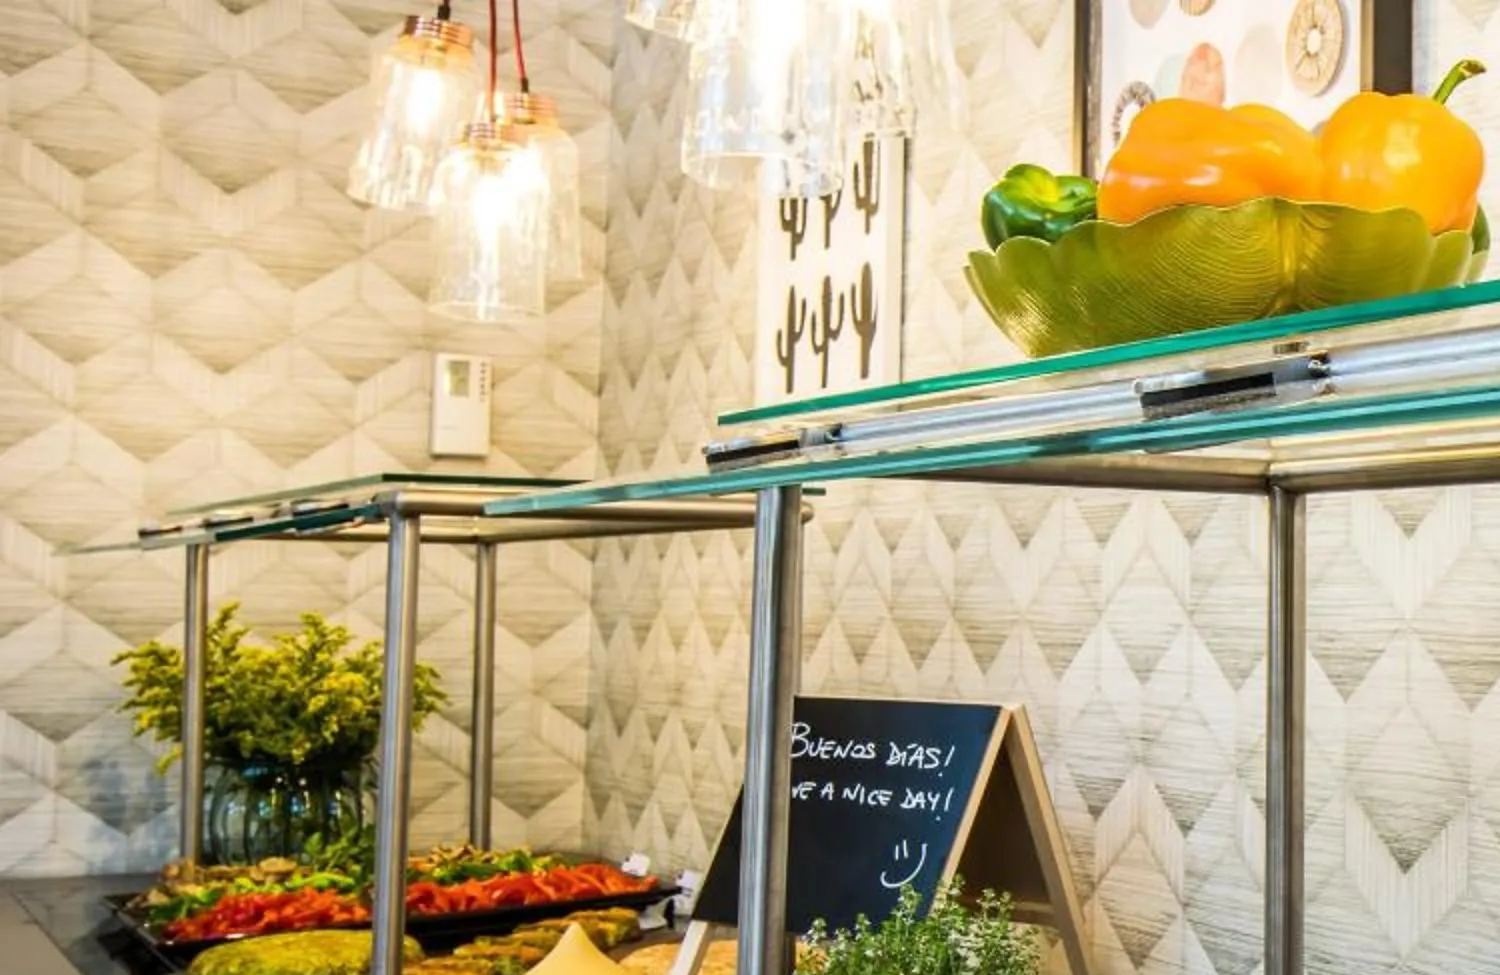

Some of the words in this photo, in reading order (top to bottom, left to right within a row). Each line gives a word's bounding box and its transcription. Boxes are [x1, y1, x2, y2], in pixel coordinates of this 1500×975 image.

[790, 722, 877, 760] BUENOS
[821, 781, 835, 801] A
[842, 783, 893, 807] NICE
[900, 787, 955, 822] DAY!
